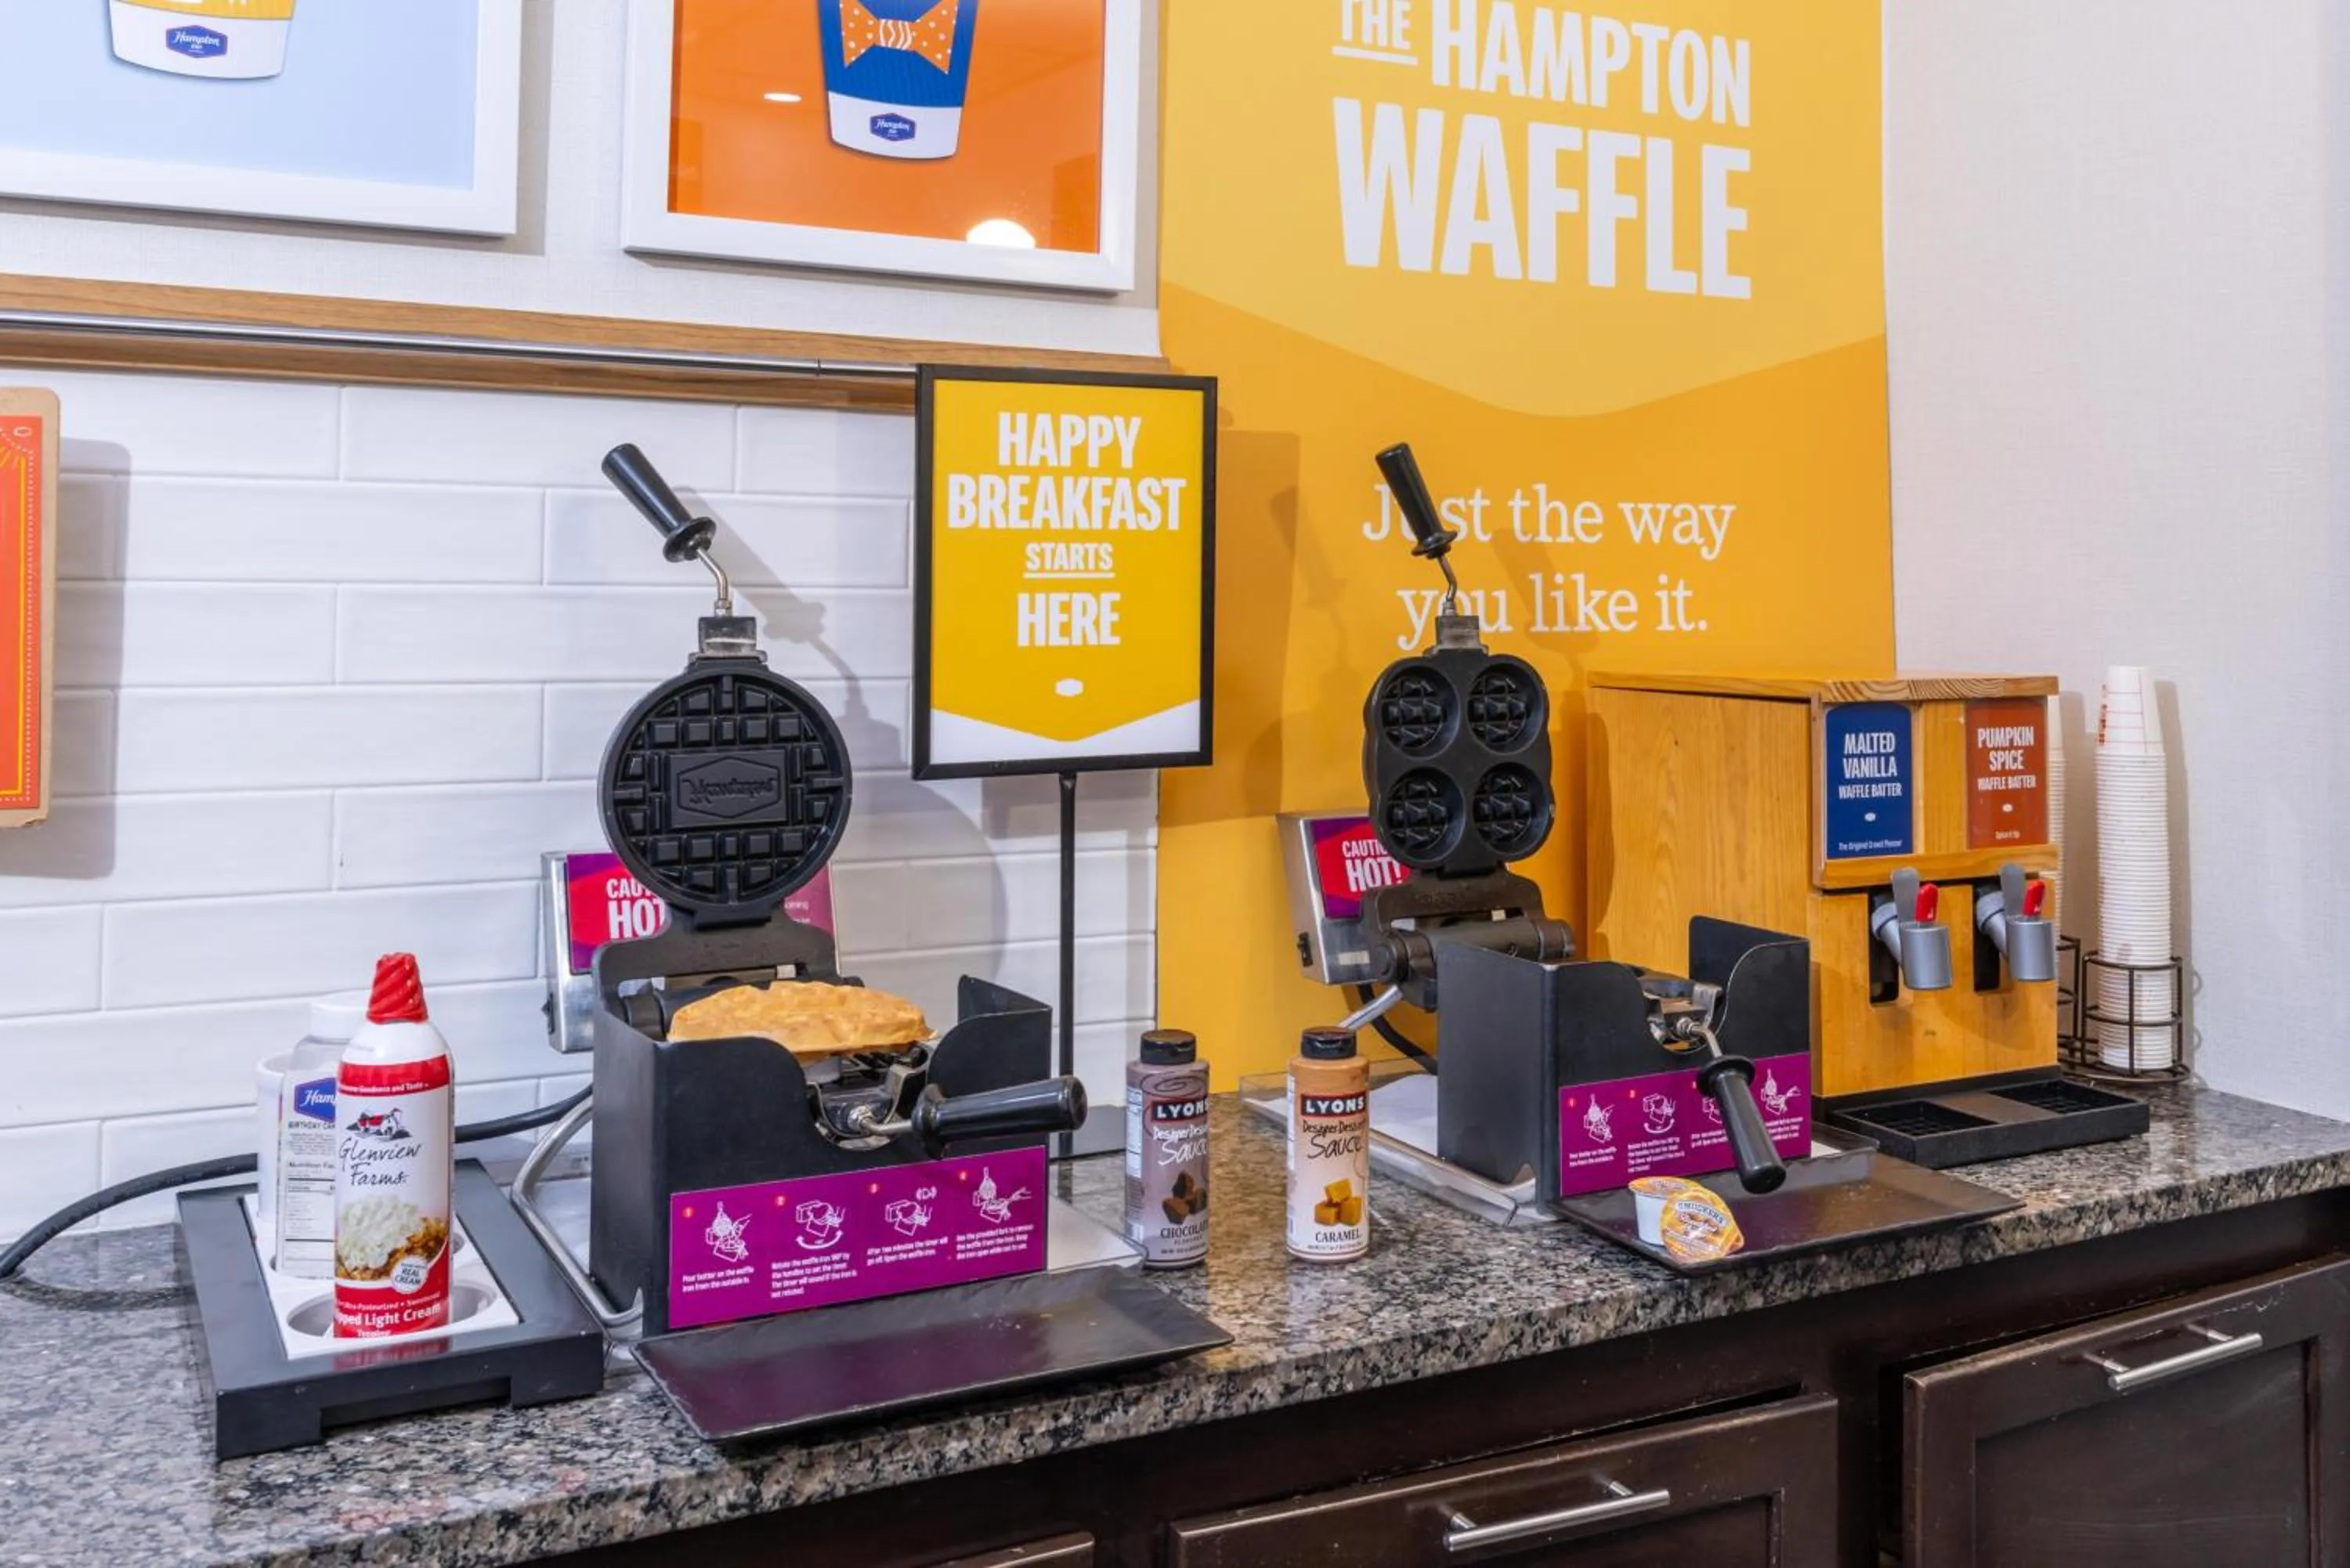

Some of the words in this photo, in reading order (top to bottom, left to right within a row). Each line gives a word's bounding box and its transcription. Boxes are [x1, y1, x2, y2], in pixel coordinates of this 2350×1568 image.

[172, 31, 220, 47] Hampton
[1339, 0, 1411, 51] THE
[1430, 0, 1751, 127] HAMPTON
[874, 118, 910, 131] Hampton
[1332, 96, 1752, 300] WAFFLE
[998, 412, 1142, 469] HAPPY
[946, 473, 1188, 531] BREAKFAST
[1507, 482, 1604, 544] the
[1618, 500, 1737, 562] way
[1025, 542, 1114, 571] STARTS
[1530, 573, 1639, 634] like
[1654, 575, 1709, 631] it.
[1017, 593, 1122, 647] HERE
[1844, 732, 1896, 754] MALTED
[1977, 727, 2034, 748] PUMPKIN
[1842, 756, 1898, 779] VANILLA
[1989, 750, 2025, 771] SPICE
[1838, 784, 1869, 800] WAFFLE
[1871, 783, 1903, 797] BATTER
[1977, 776, 2006, 790] WAFFLE
[2008, 775, 2037, 789] BATTER
[1306, 1097, 1364, 1114] LYONS
[338, 1136, 422, 1172] Glenview
[1315, 1227, 1362, 1243] CARAMEL
[394, 1275, 421, 1285] CREAM
[402, 1266, 421, 1277] REAL
[365, 1311, 400, 1328] Light
[403, 1302, 441, 1322] Cream
